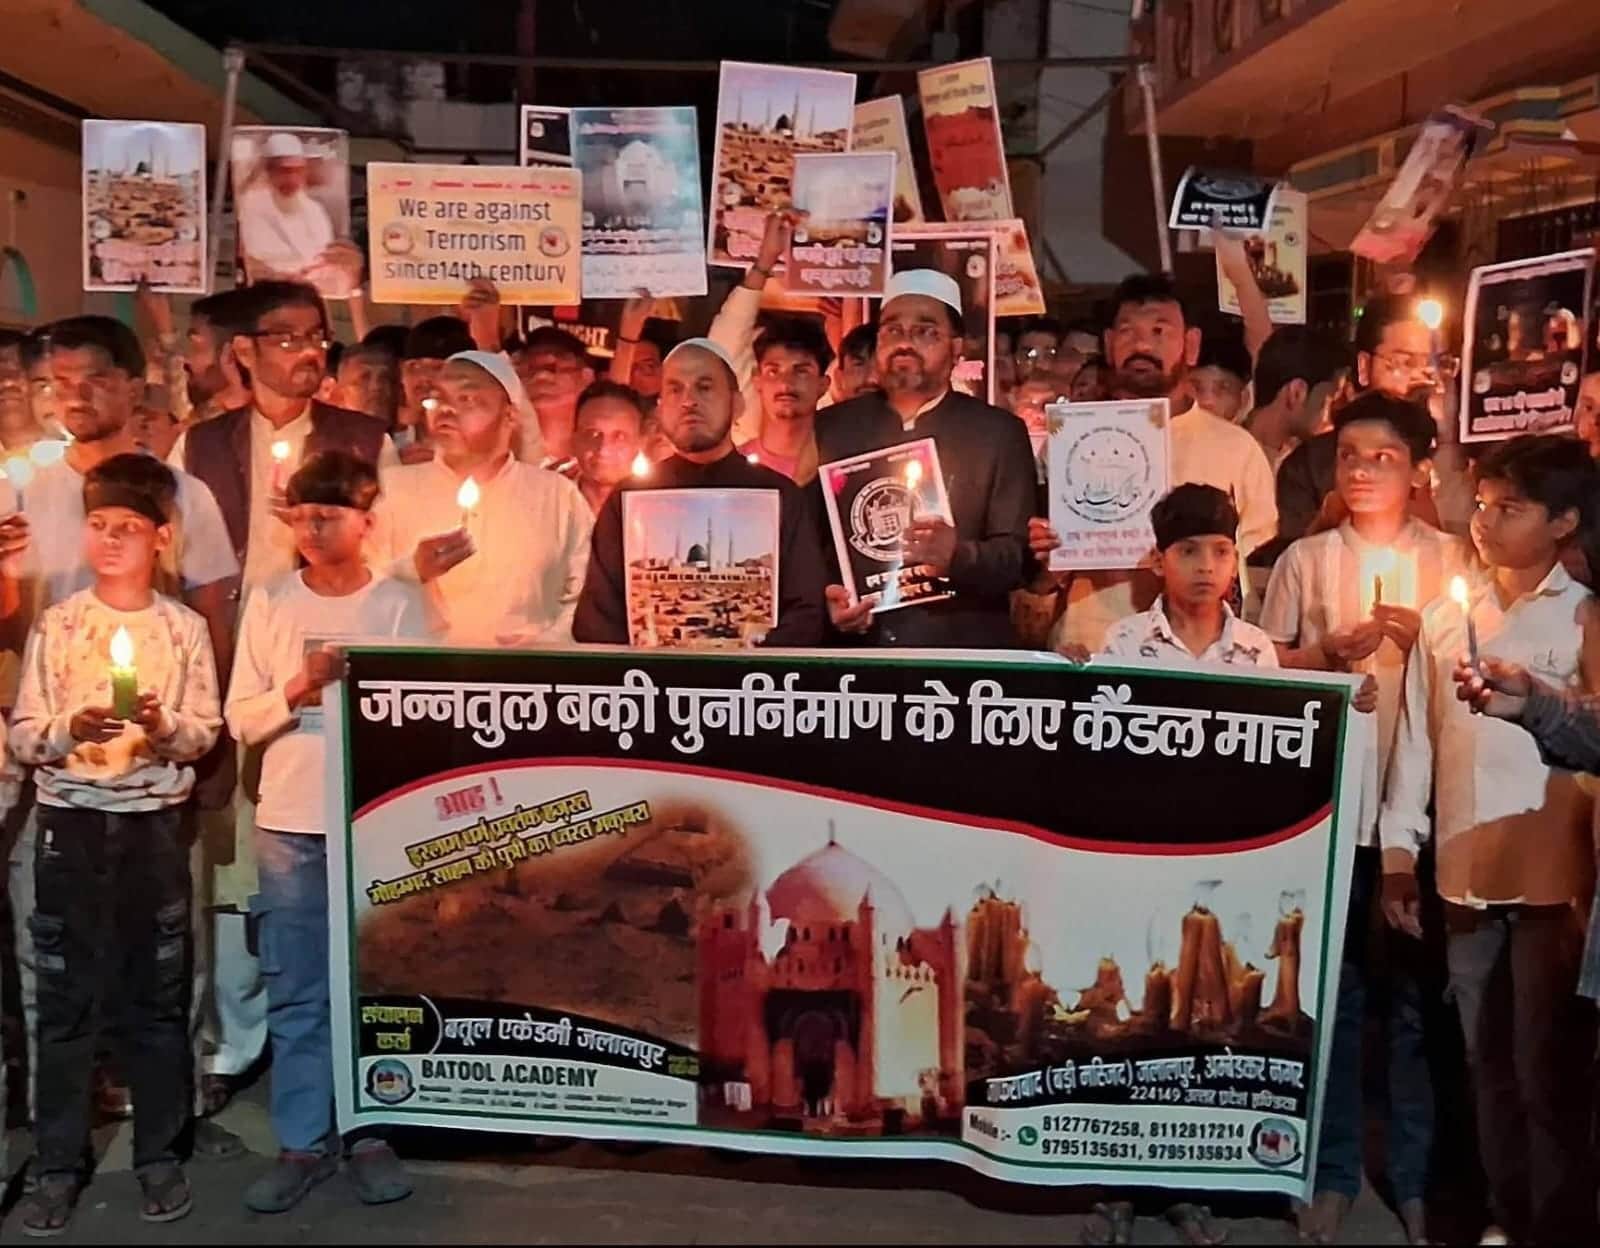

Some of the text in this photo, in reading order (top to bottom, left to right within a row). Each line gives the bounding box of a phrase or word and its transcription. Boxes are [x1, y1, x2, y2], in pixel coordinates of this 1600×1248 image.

[398, 198, 552, 224] We are against
[426, 229, 526, 251] Terrorism
[489, 262, 566, 284] century
[358, 680, 552, 748] जन्नतुल
[665, 672, 897, 754] पुनर्निर्माण
[904, 680, 959, 742] के
[967, 679, 1066, 751] लिए
[1072, 683, 1211, 758] कैंडल
[1215, 701, 1321, 768] मार्च
[444, 1017, 494, 1046] बतूल
[497, 1013, 571, 1046] एकेडमी
[576, 1027, 666, 1068] जलालपुर
[421, 1059, 598, 1088] BATOOL ACADEMY
[1129, 1085, 1181, 1102] 224149
[1042, 1115, 1145, 1138] 8127767258,
[1041, 1138, 1144, 1161] 9795135631,
